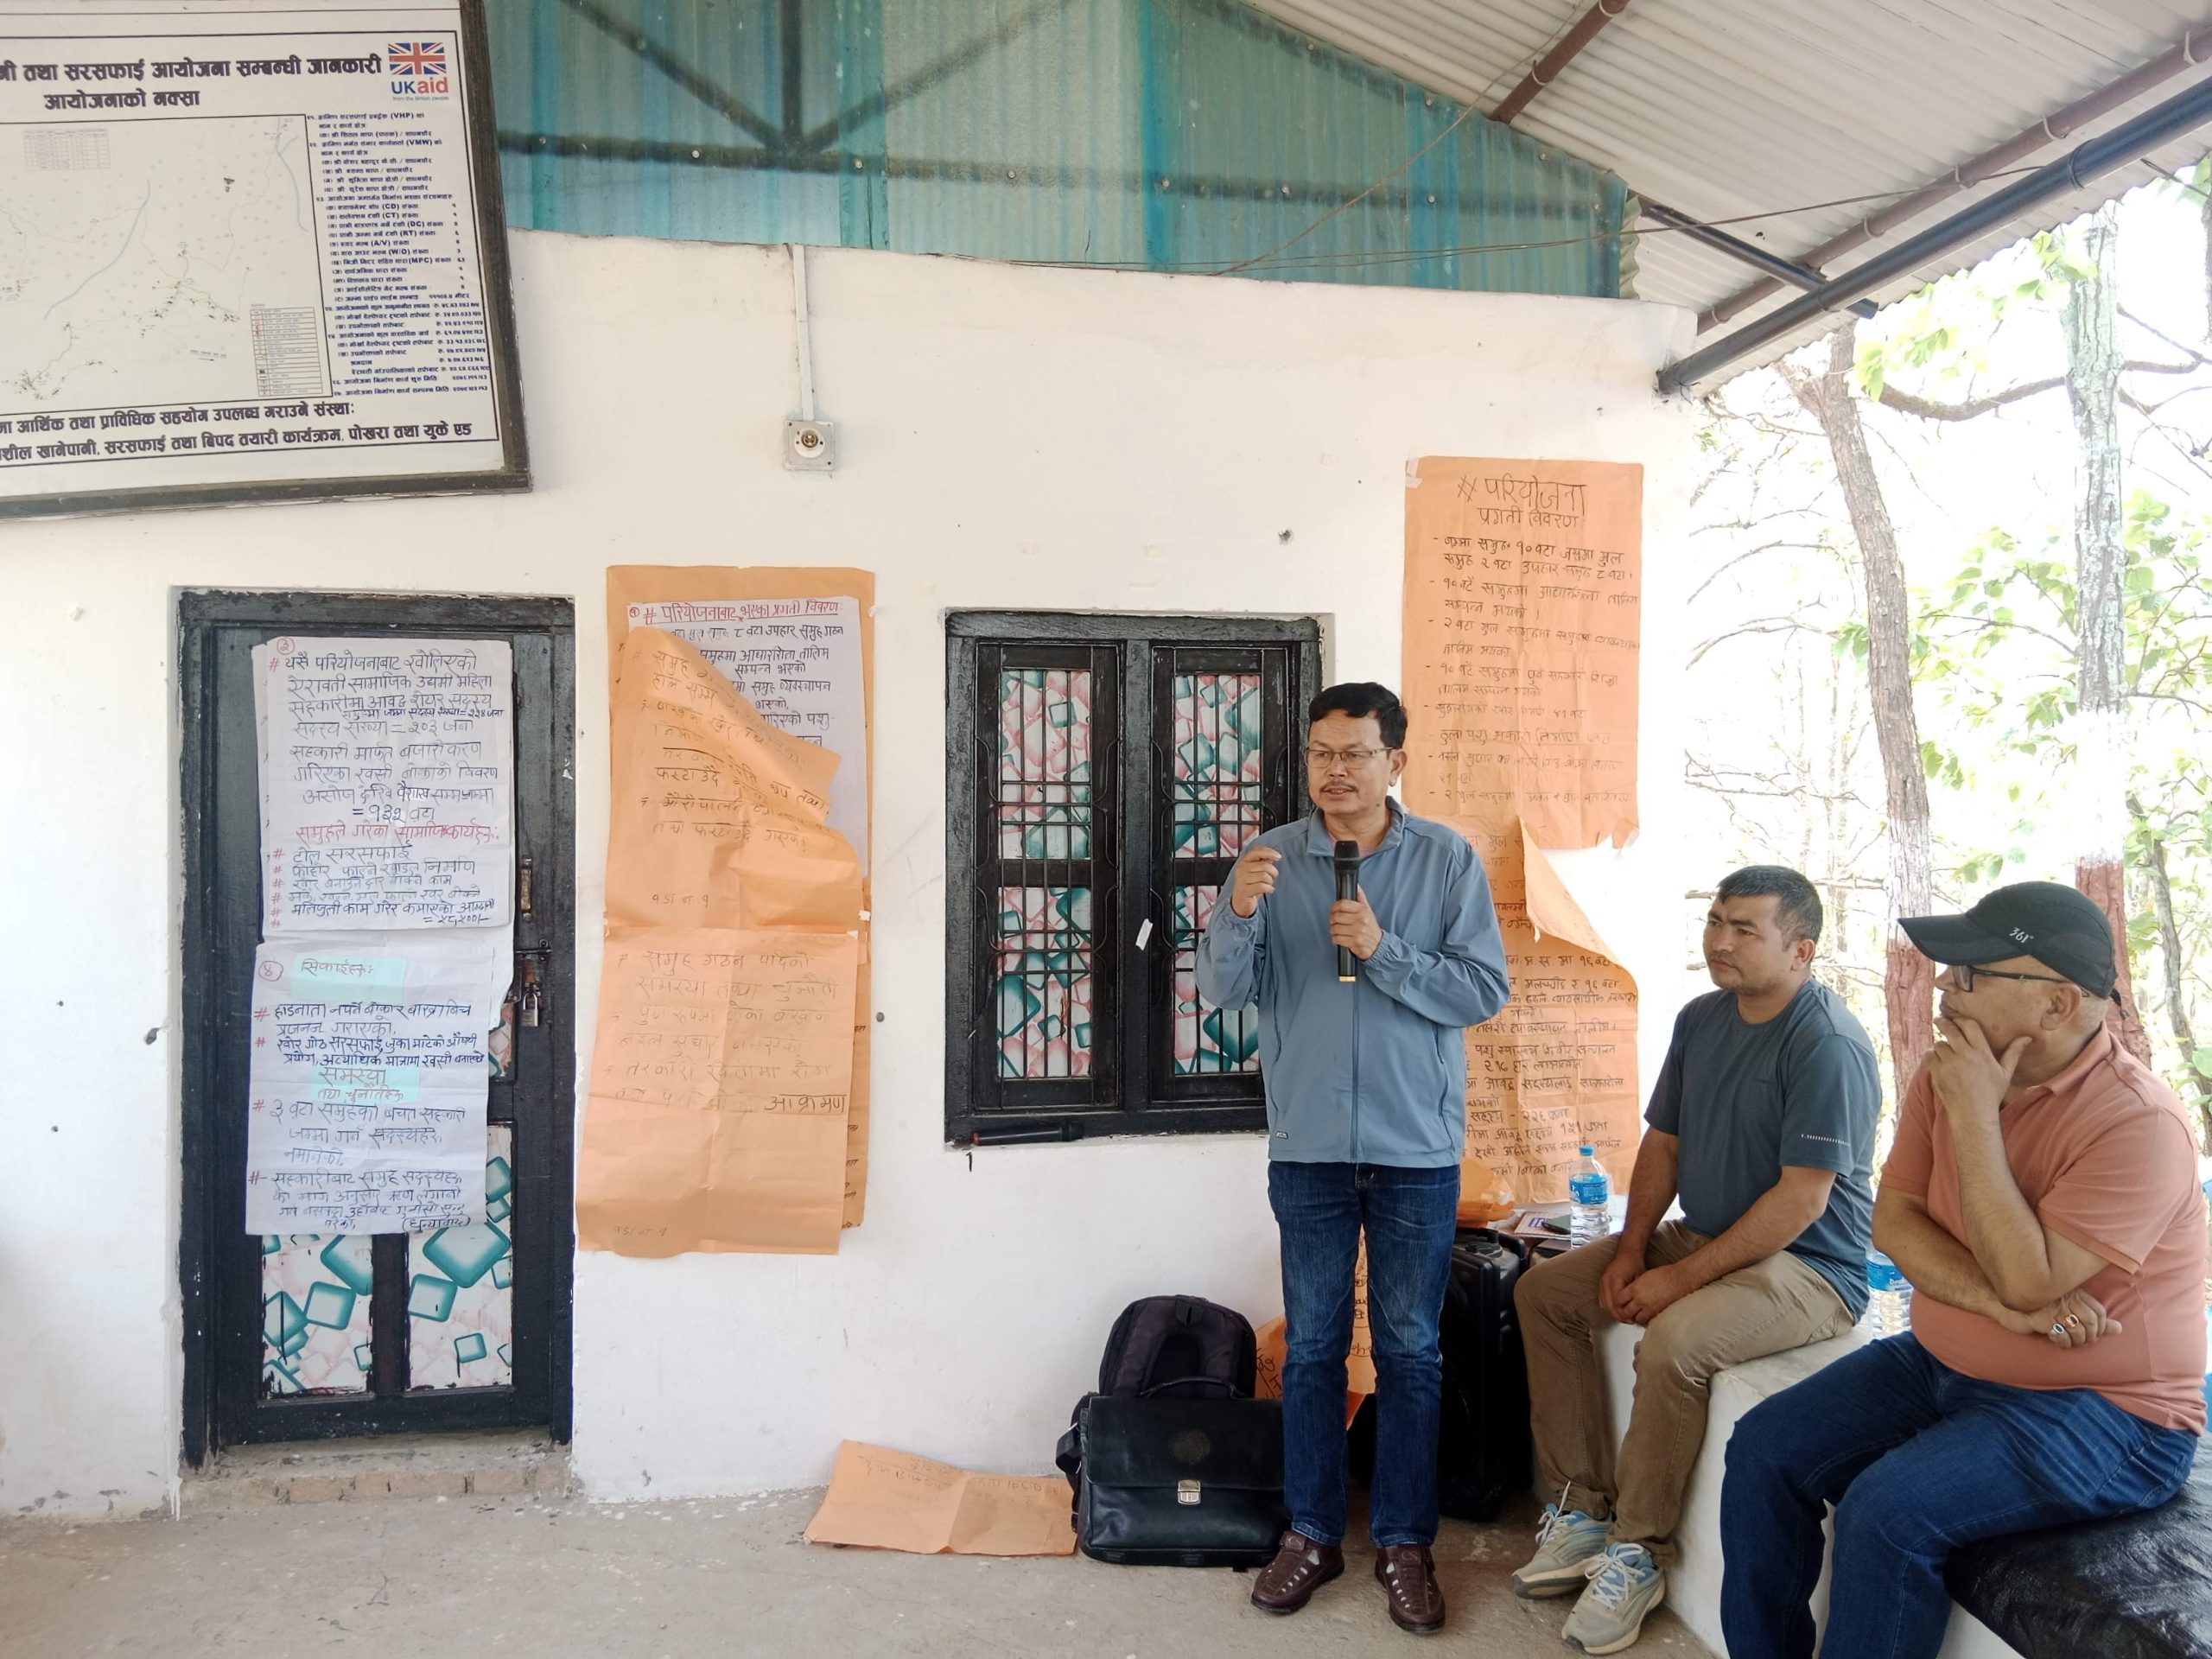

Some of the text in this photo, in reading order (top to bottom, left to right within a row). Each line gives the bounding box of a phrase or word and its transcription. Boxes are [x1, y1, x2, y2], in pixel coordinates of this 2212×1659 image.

[22, 53, 381, 82] तथा सरसफाई आयोजना सम्बन्धी जानकारी
[44, 88, 200, 110] आयोजनाको नक्सा
[16, 416, 65, 433] आर्थिक
[69, 416, 95, 430] तथा
[100, 410, 156, 429] प्राविधिक
[160, 407, 208, 425] सहयोग
[213, 406, 259, 421] उपलब्ध
[264, 401, 308, 418] गराउने
[105, 435, 166, 454] सरसफाई
[171, 435, 197, 449] तथा
[201, 432, 234, 448] बिपद
[238, 429, 278, 447] तयारी
[348, 424, 389, 441] पोखरा
[394, 424, 419, 439] तथा
[423, 421, 448, 440] युके
[454, 423, 472, 435] एड
[1484, 473, 1587, 516] परियोजना
[316, 649, 401, 671] परियोजनाबाट
[348, 671, 412, 694] सामाजिक
[456, 671, 492, 690] महिला
[289, 741, 348, 762] सहकारी
[456, 760, 498, 779] विवरण
[276, 1003, 327, 1020] हाडनाता
